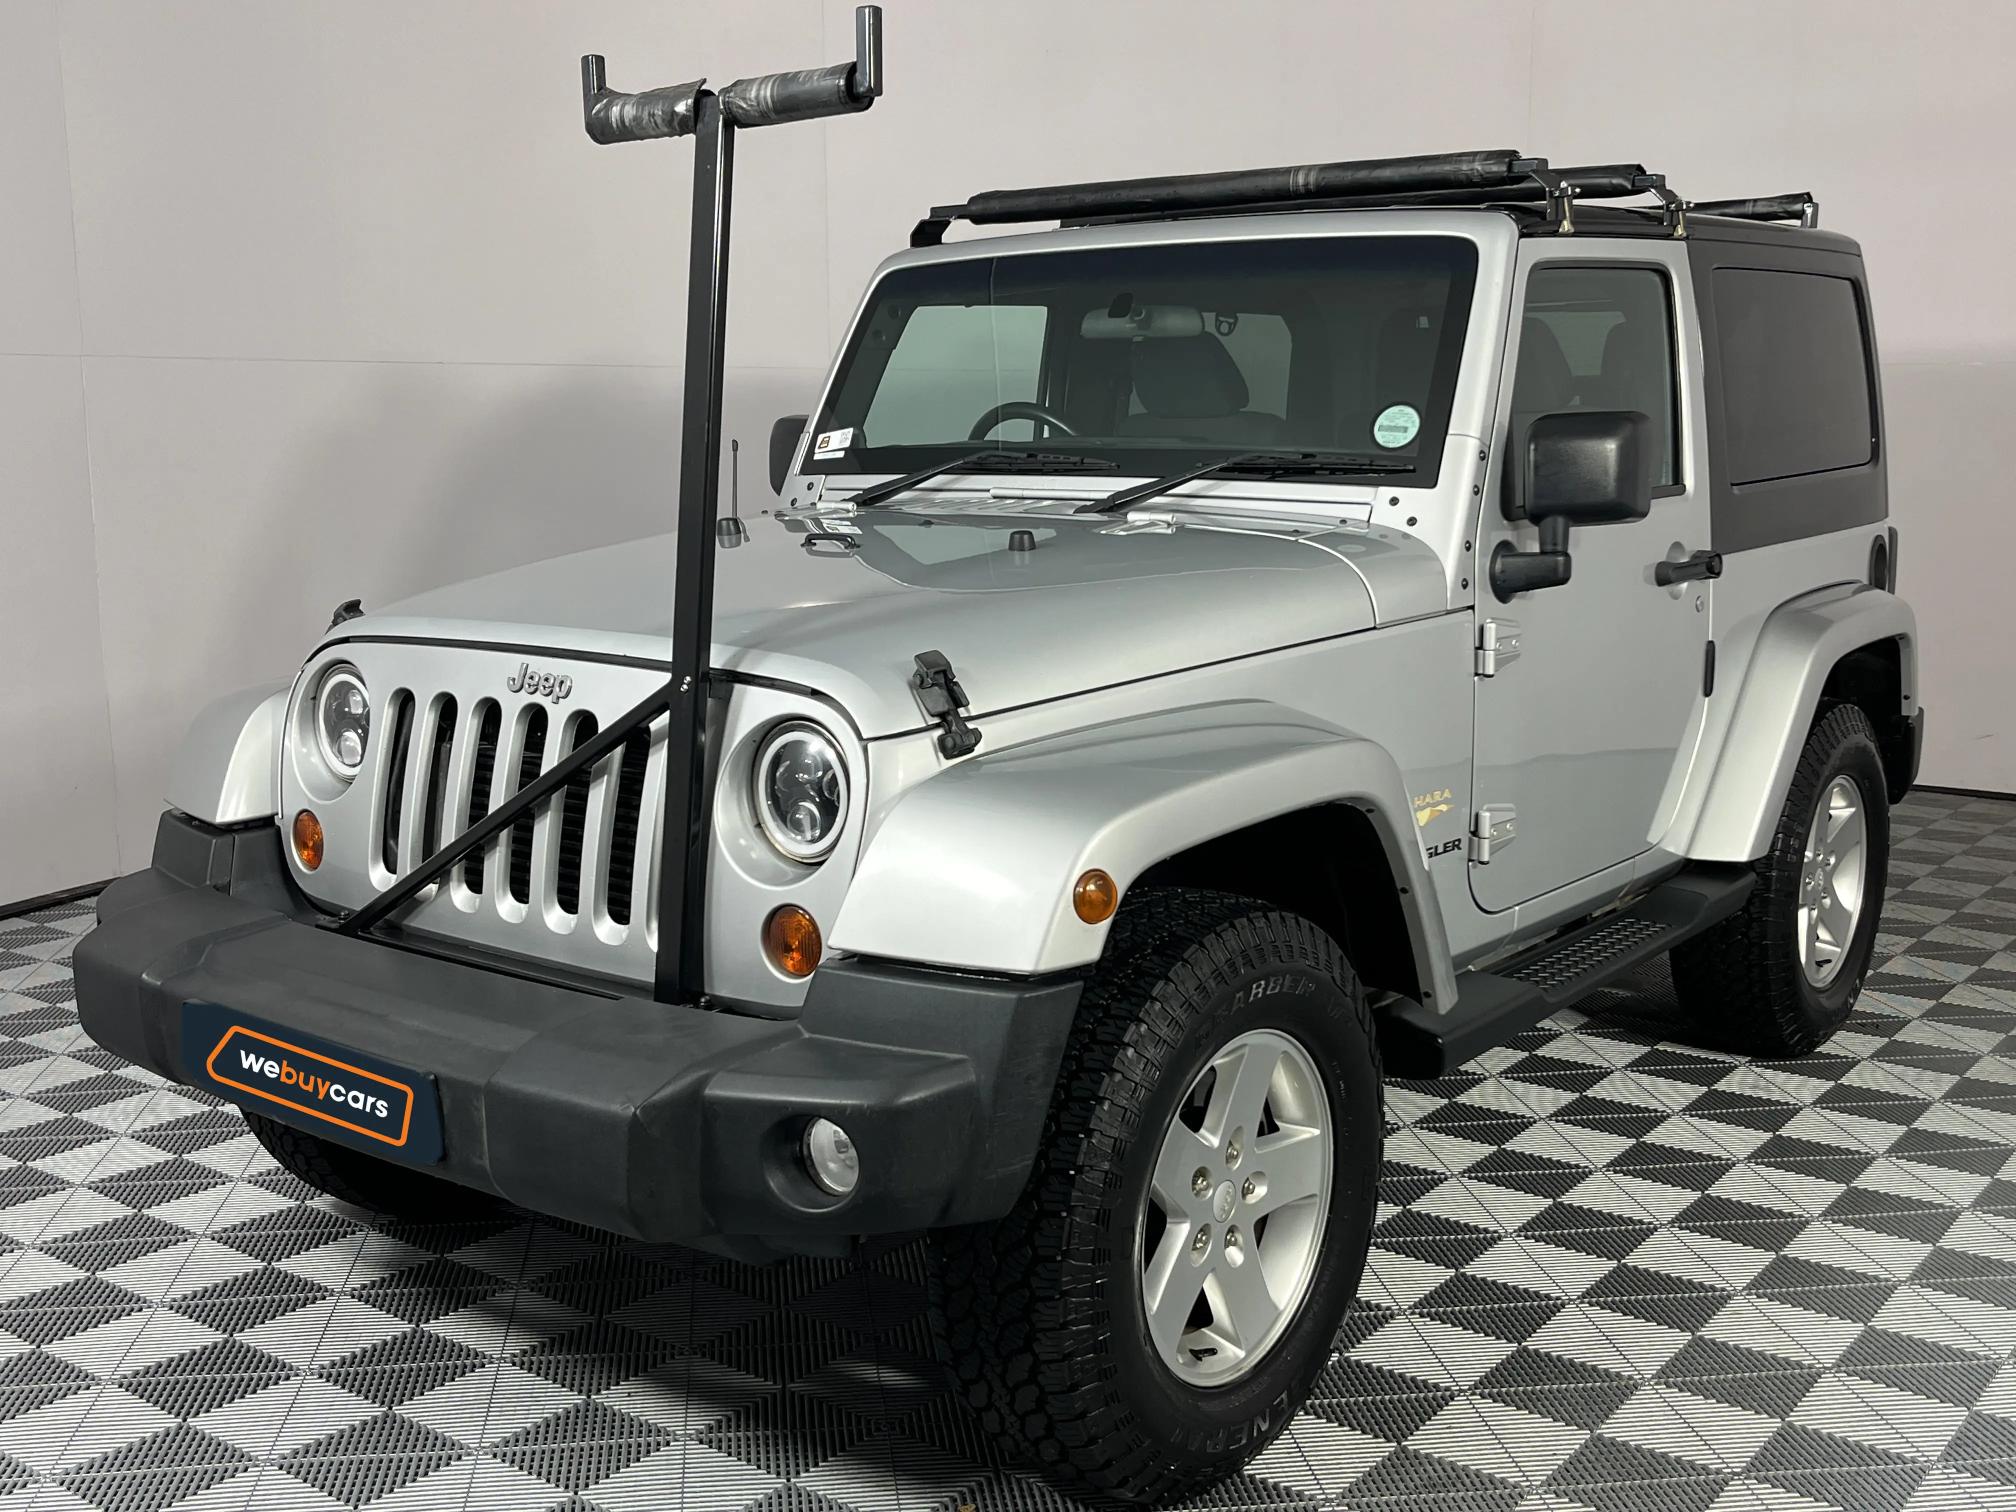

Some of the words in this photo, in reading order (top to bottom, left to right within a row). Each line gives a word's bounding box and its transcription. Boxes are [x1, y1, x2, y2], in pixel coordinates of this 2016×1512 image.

[507, 662, 573, 705] Jeep
[1413, 788, 1452, 808] HARA
[1426, 838, 1462, 859] GLER
[239, 1049, 389, 1118] webuycars
